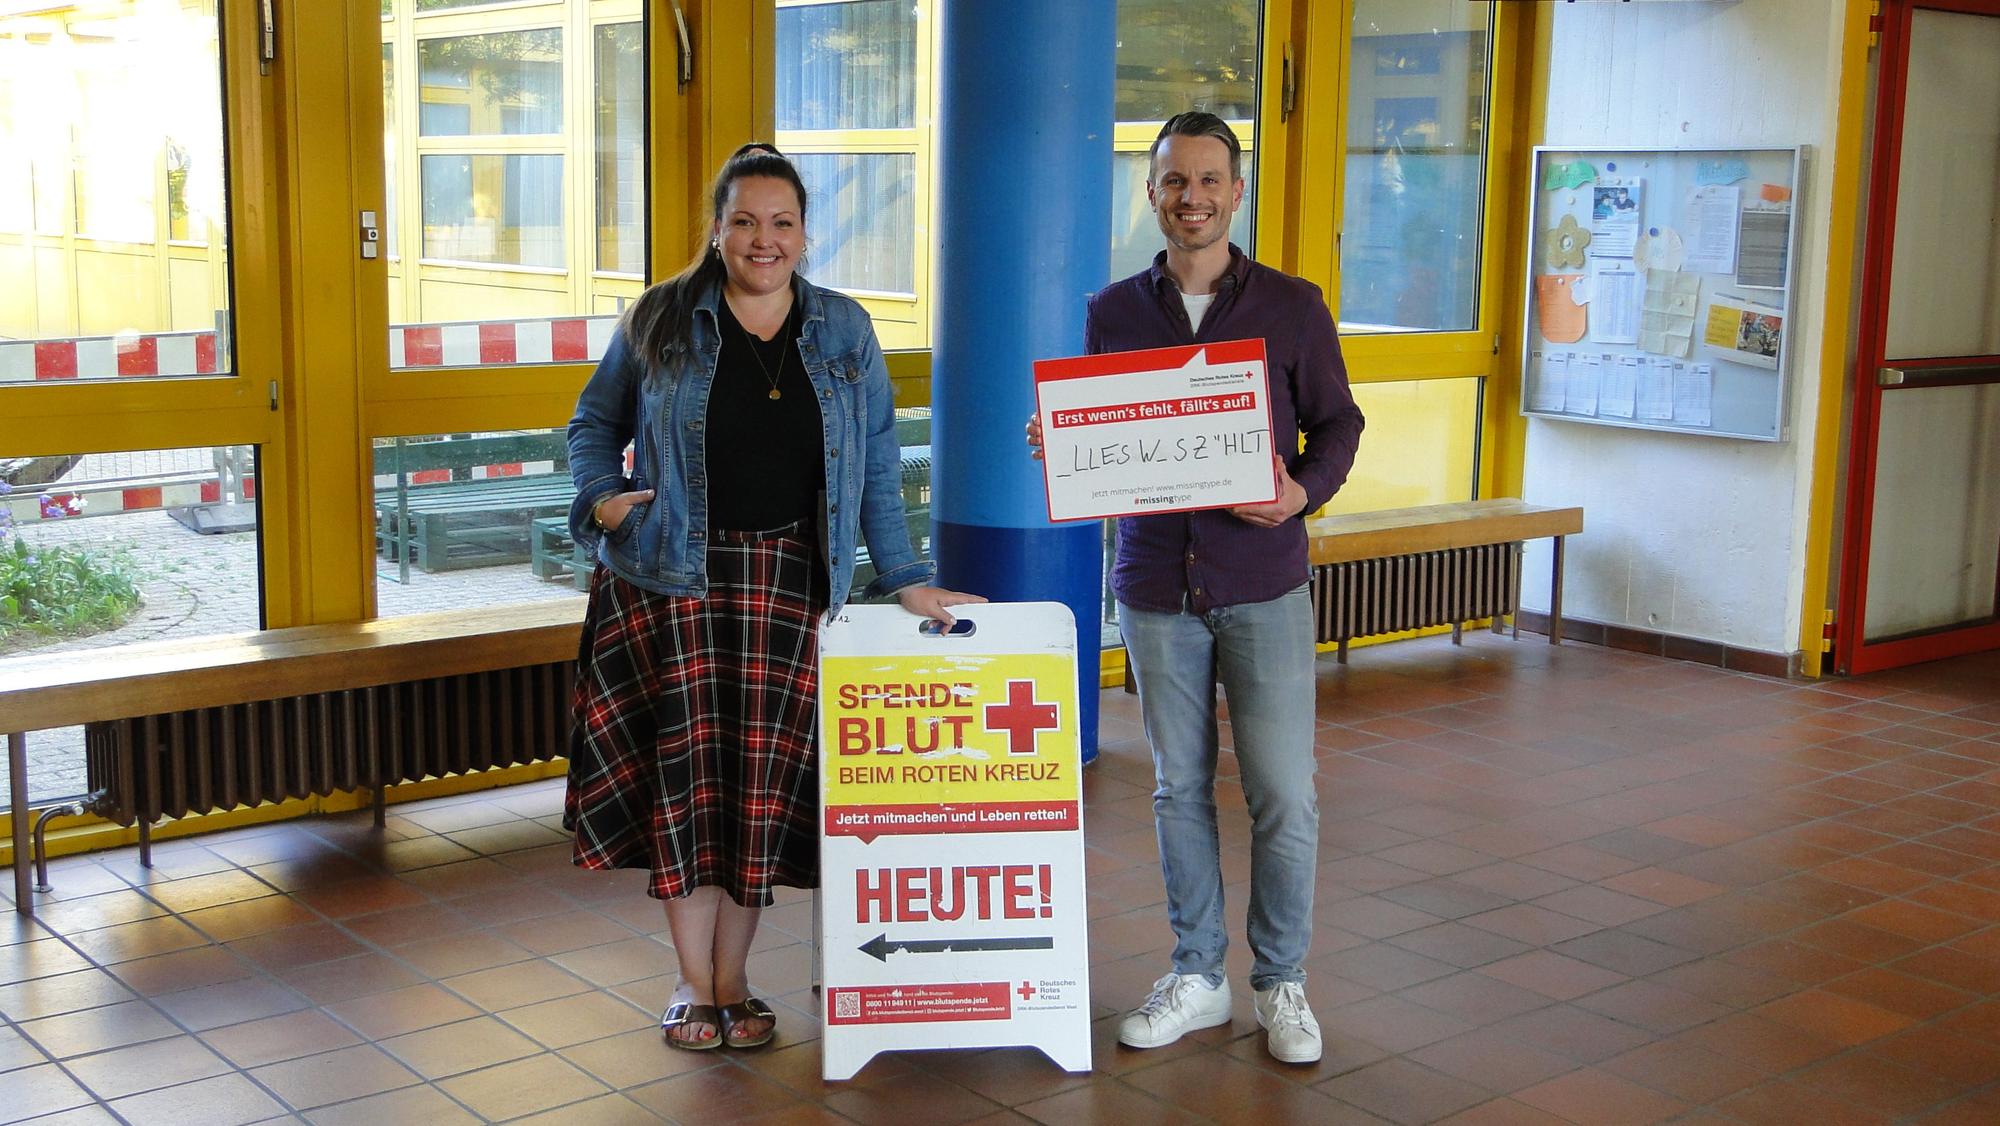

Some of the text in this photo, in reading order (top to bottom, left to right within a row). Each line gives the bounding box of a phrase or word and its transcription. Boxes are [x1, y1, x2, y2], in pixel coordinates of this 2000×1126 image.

[1057, 412, 1084, 426] Erst
[1139, 403, 1177, 418] fehlt,
[1224, 395, 1251, 409] auf!
[1110, 485, 1155, 497] mitmachen!
[1156, 479, 1233, 492] www.missingtype.de
[1134, 493, 1192, 505] #missingtype
[838, 682, 974, 709] SPENDE
[838, 715, 974, 756] BLUT
[839, 763, 1060, 784] BEIM ROTEN KREUZ
[836, 807, 1067, 825] Jetzt mitmachen und Leben retten!
[855, 864, 1053, 923] HEUTE!
[917, 997, 988, 1006] www.blutspende.jetzt
